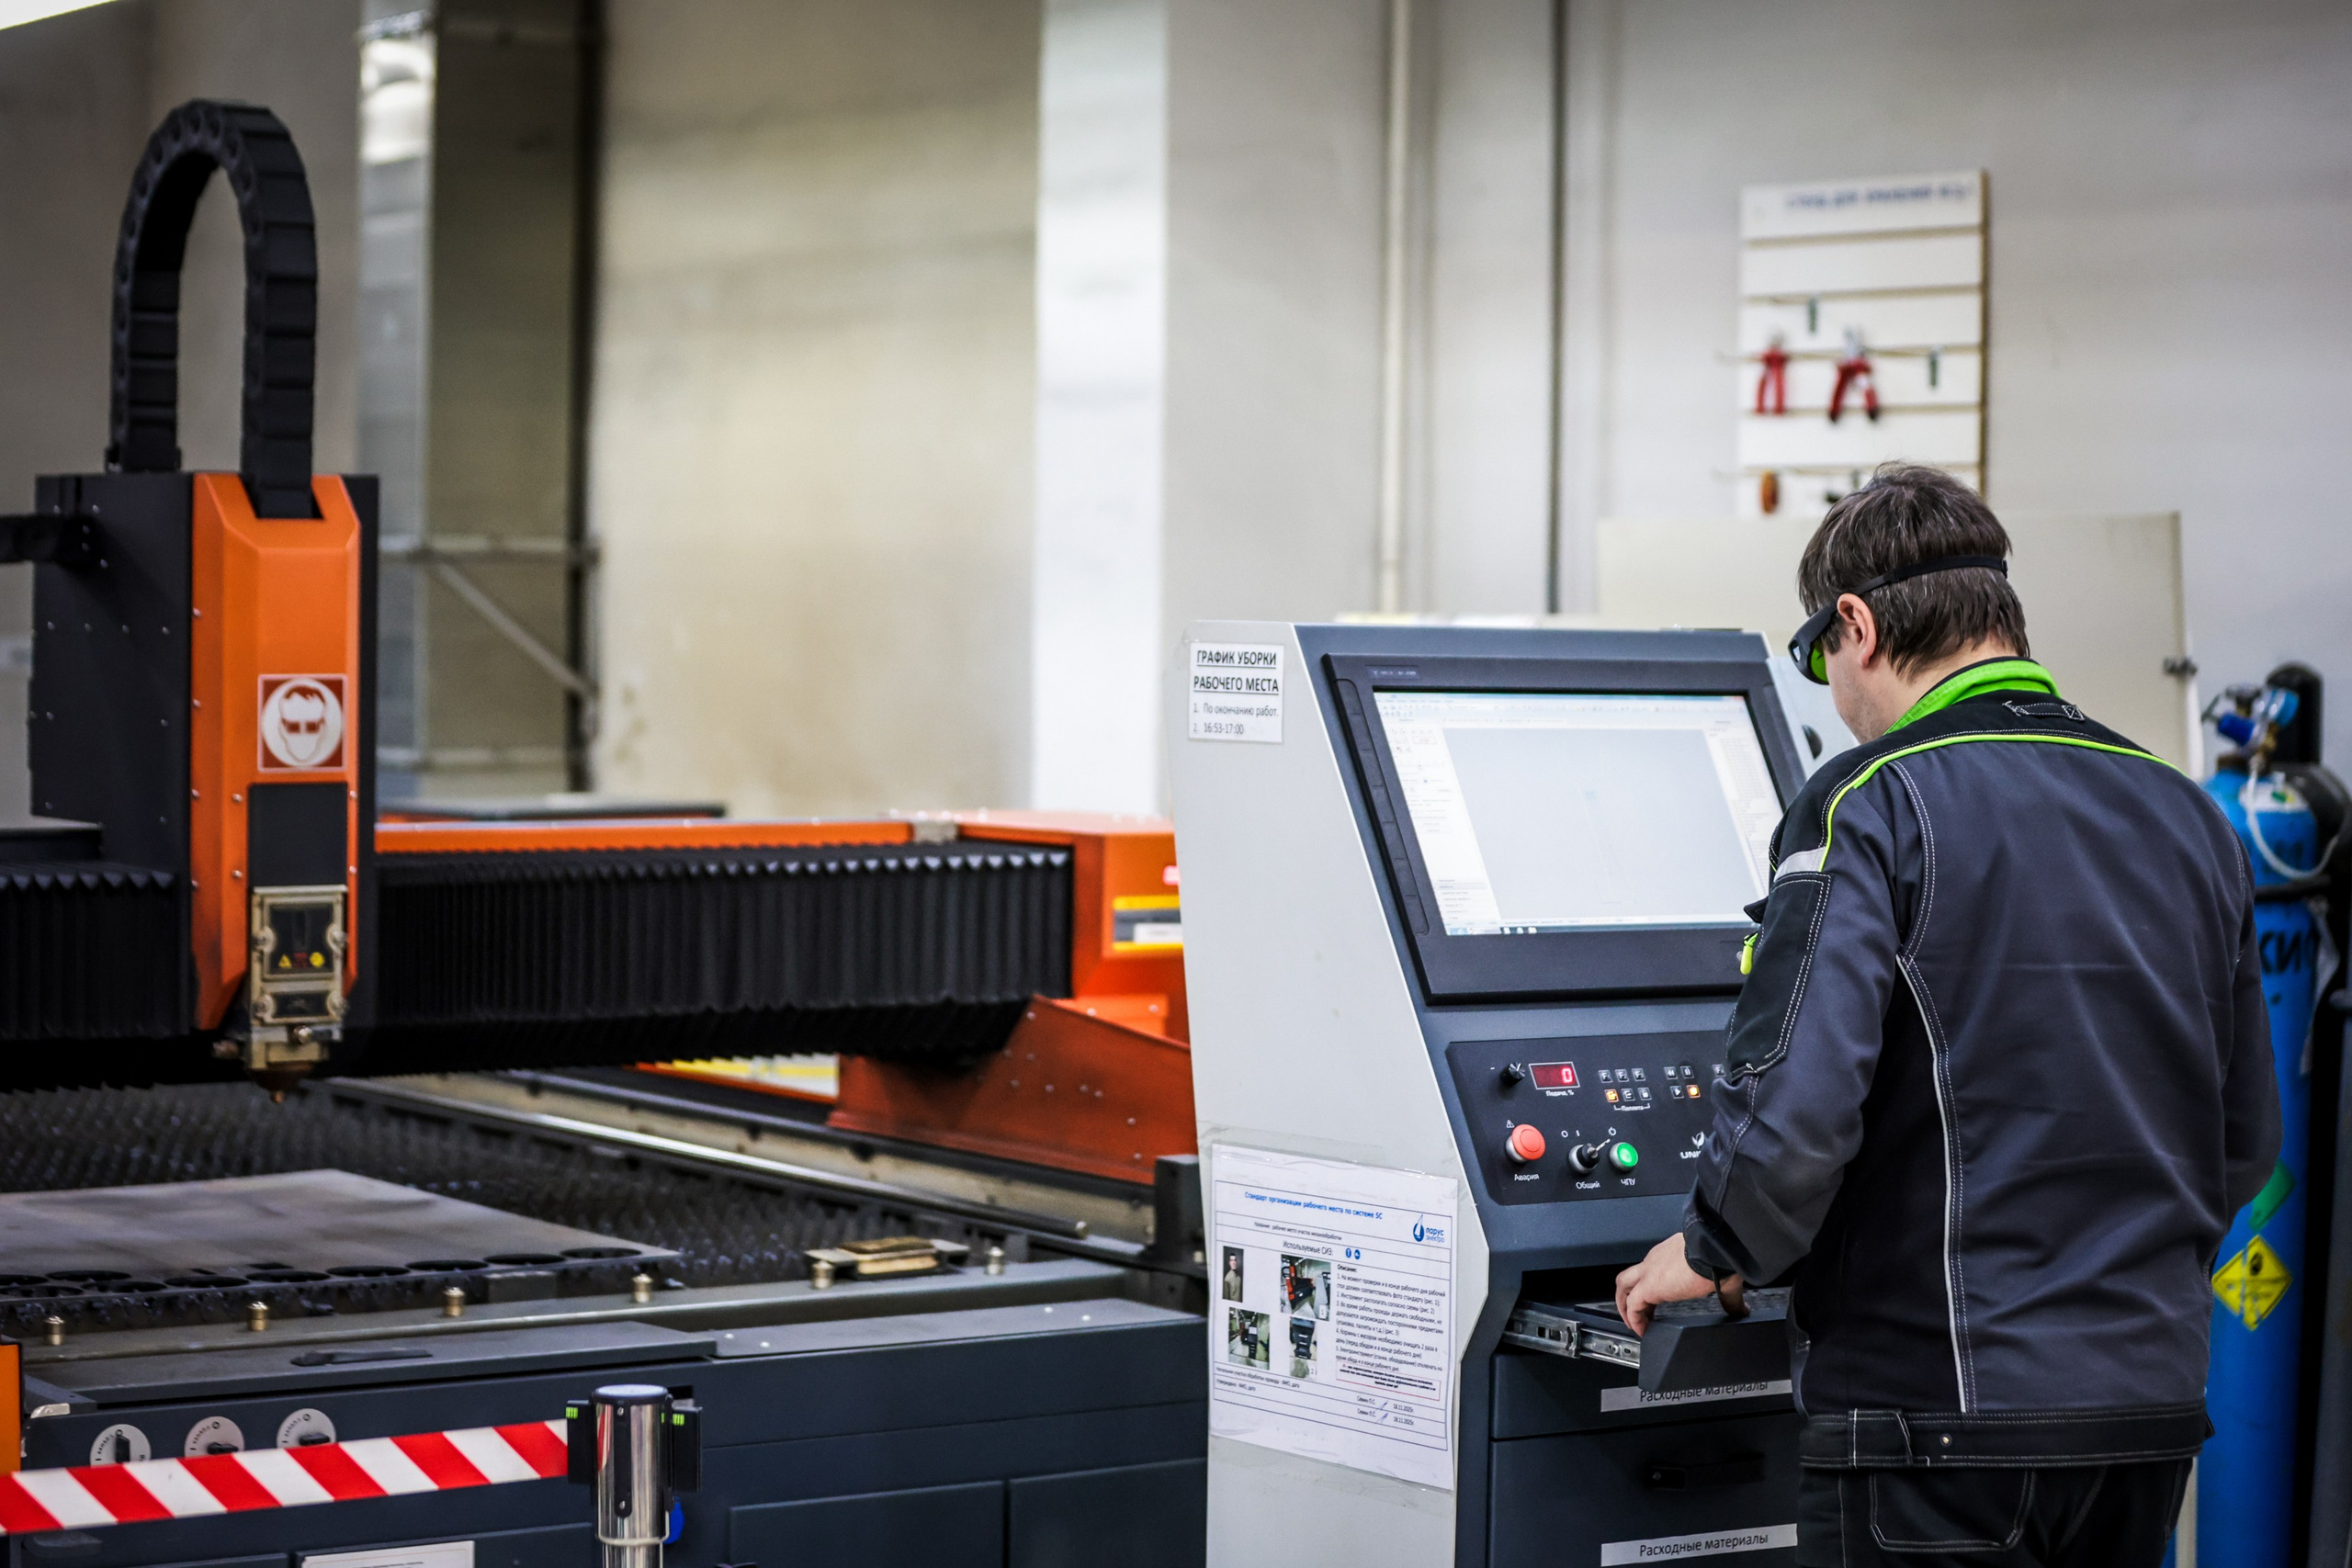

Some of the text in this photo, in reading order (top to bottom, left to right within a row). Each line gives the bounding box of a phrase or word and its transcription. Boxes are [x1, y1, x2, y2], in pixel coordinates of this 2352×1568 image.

[1197, 650, 1277, 665] ГРАФИК УБОРКИ
[1193, 676, 1279, 692] РАБОЧЕГО МЕСТА
[1204, 703, 1213, 714] По
[1215, 705, 1254, 716] окончанию
[1514, 1173, 1540, 1182] Авария
[1621, 1178, 1635, 1186] ЧПУ
[1576, 1180, 1600, 1190] Общий
[1244, 1191, 1267, 1201] Стандарт
[1268, 1196, 1301, 1206] организации
[1303, 1201, 1327, 1211] рабочего
[1426, 1227, 1443, 1235] парус
[1425, 1234, 1444, 1242] электро
[1283, 1240, 1319, 1253] Используемые
[1640, 1382, 1769, 1403] Расходные материалы
[1640, 1534, 1769, 1557] Расходные материалы
